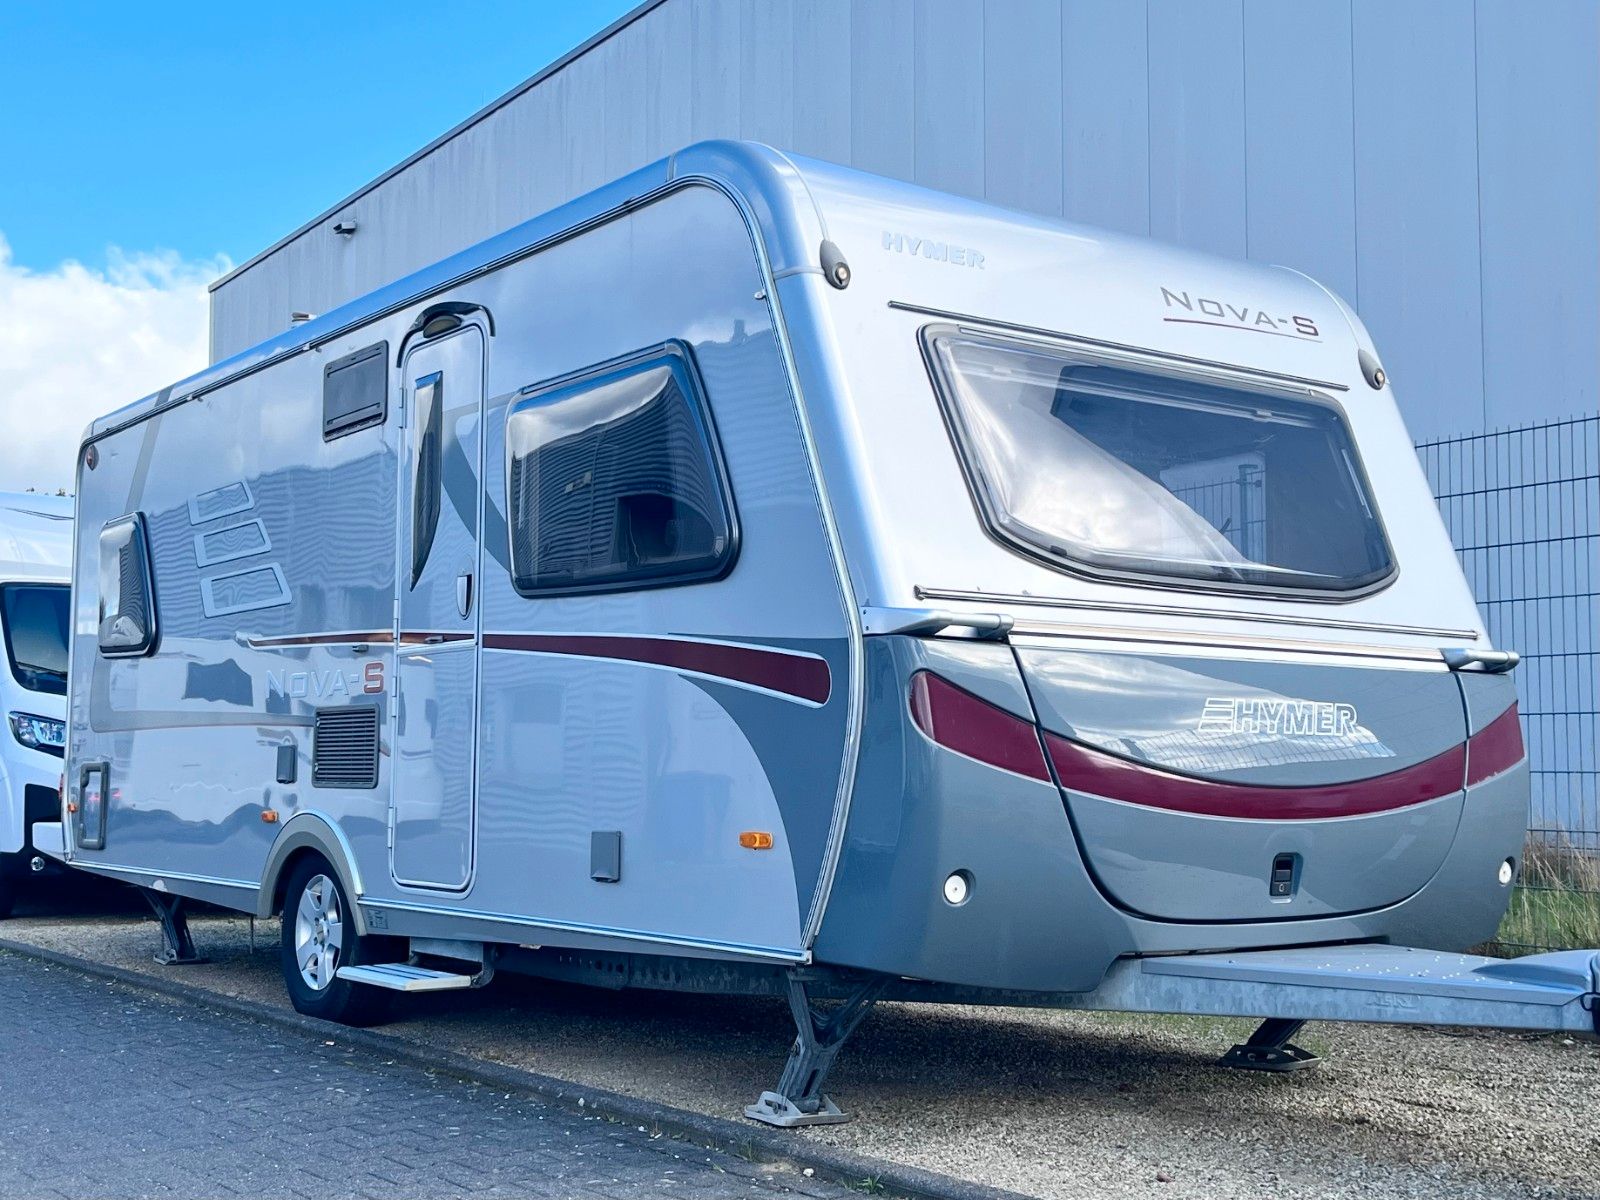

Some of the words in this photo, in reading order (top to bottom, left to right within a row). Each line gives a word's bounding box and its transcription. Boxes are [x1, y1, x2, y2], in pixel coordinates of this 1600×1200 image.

[881, 230, 985, 269] HYMER
[1160, 286, 1319, 336] NOVA-S
[1233, 699, 1357, 736] HYMER
